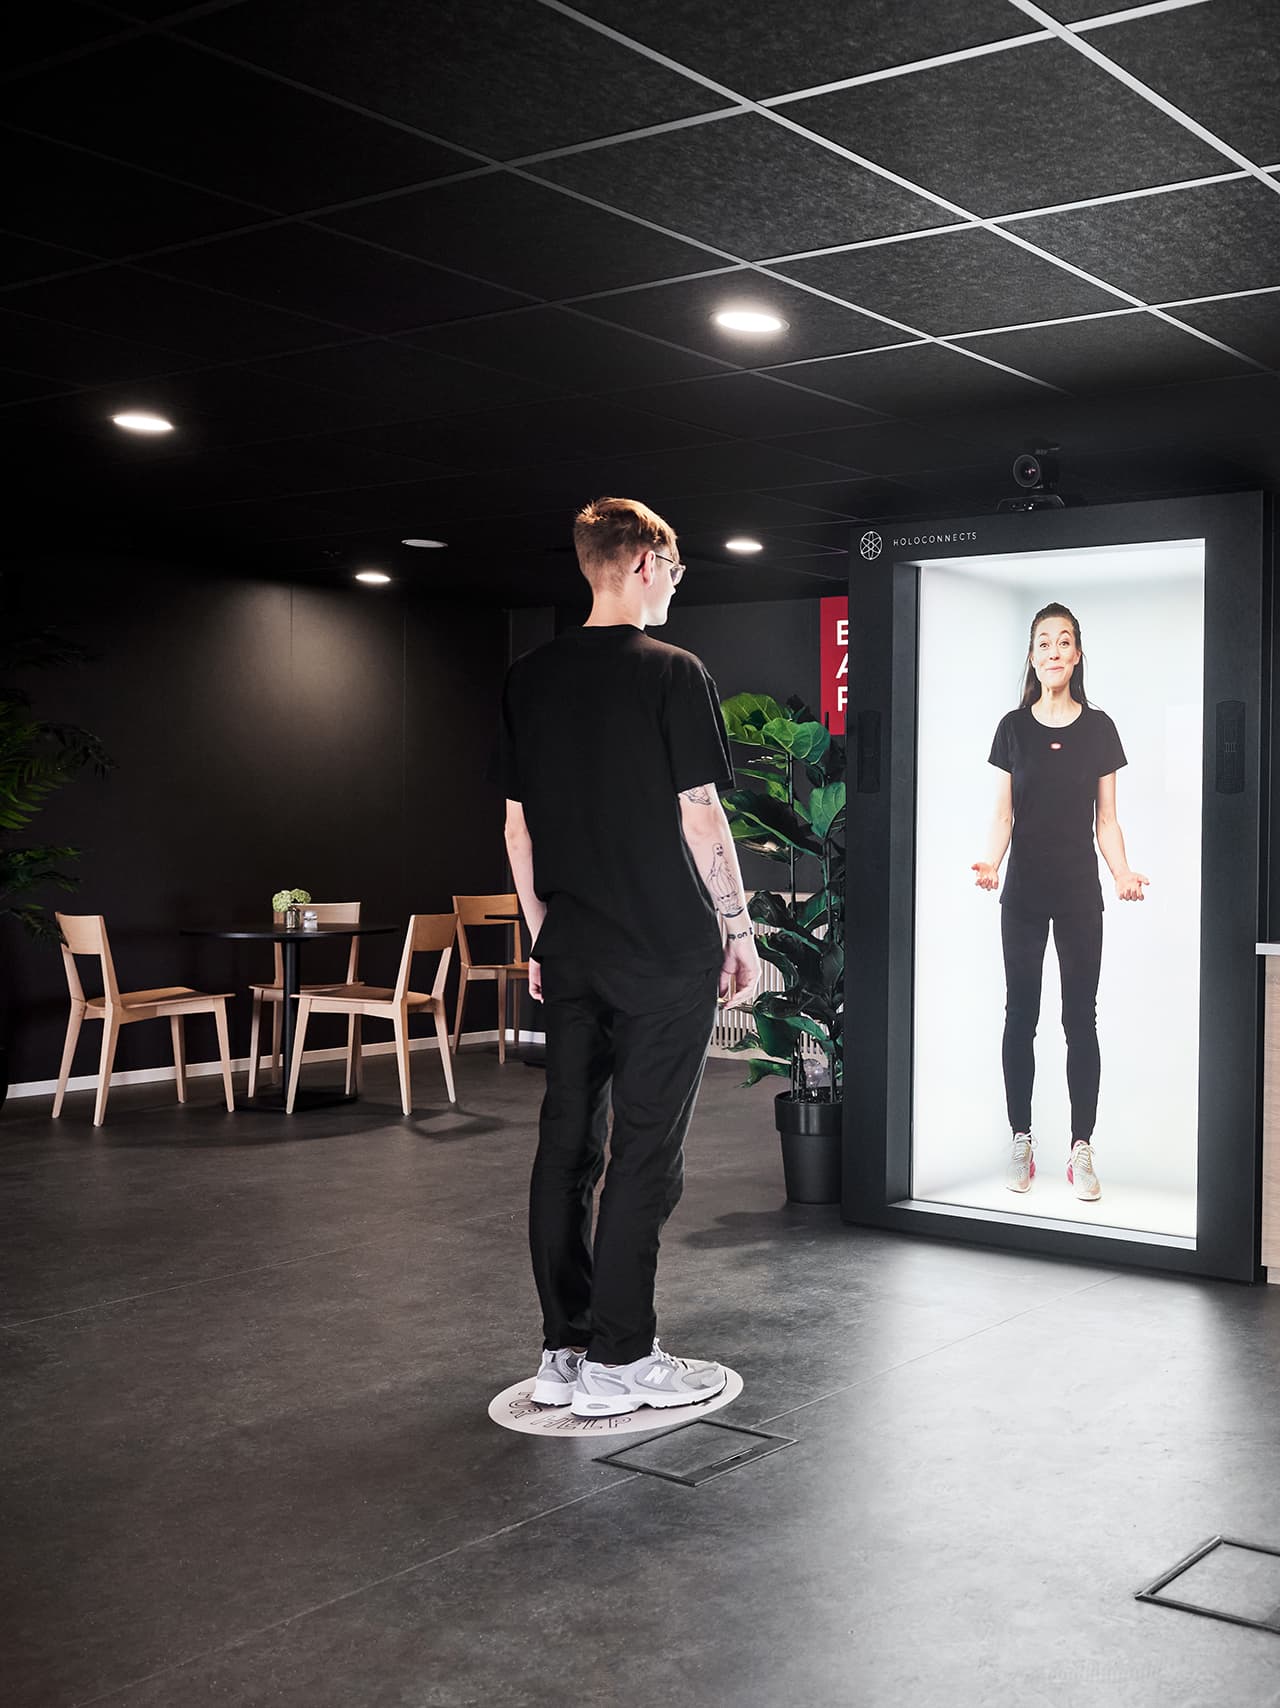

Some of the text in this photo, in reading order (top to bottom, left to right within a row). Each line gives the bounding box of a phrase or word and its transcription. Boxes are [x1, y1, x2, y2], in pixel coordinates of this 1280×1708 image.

[893, 531, 977, 547] HOLOCONNECTS
[644, 1366, 669, 1385] N
[530, 1415, 632, 1431] HELP
